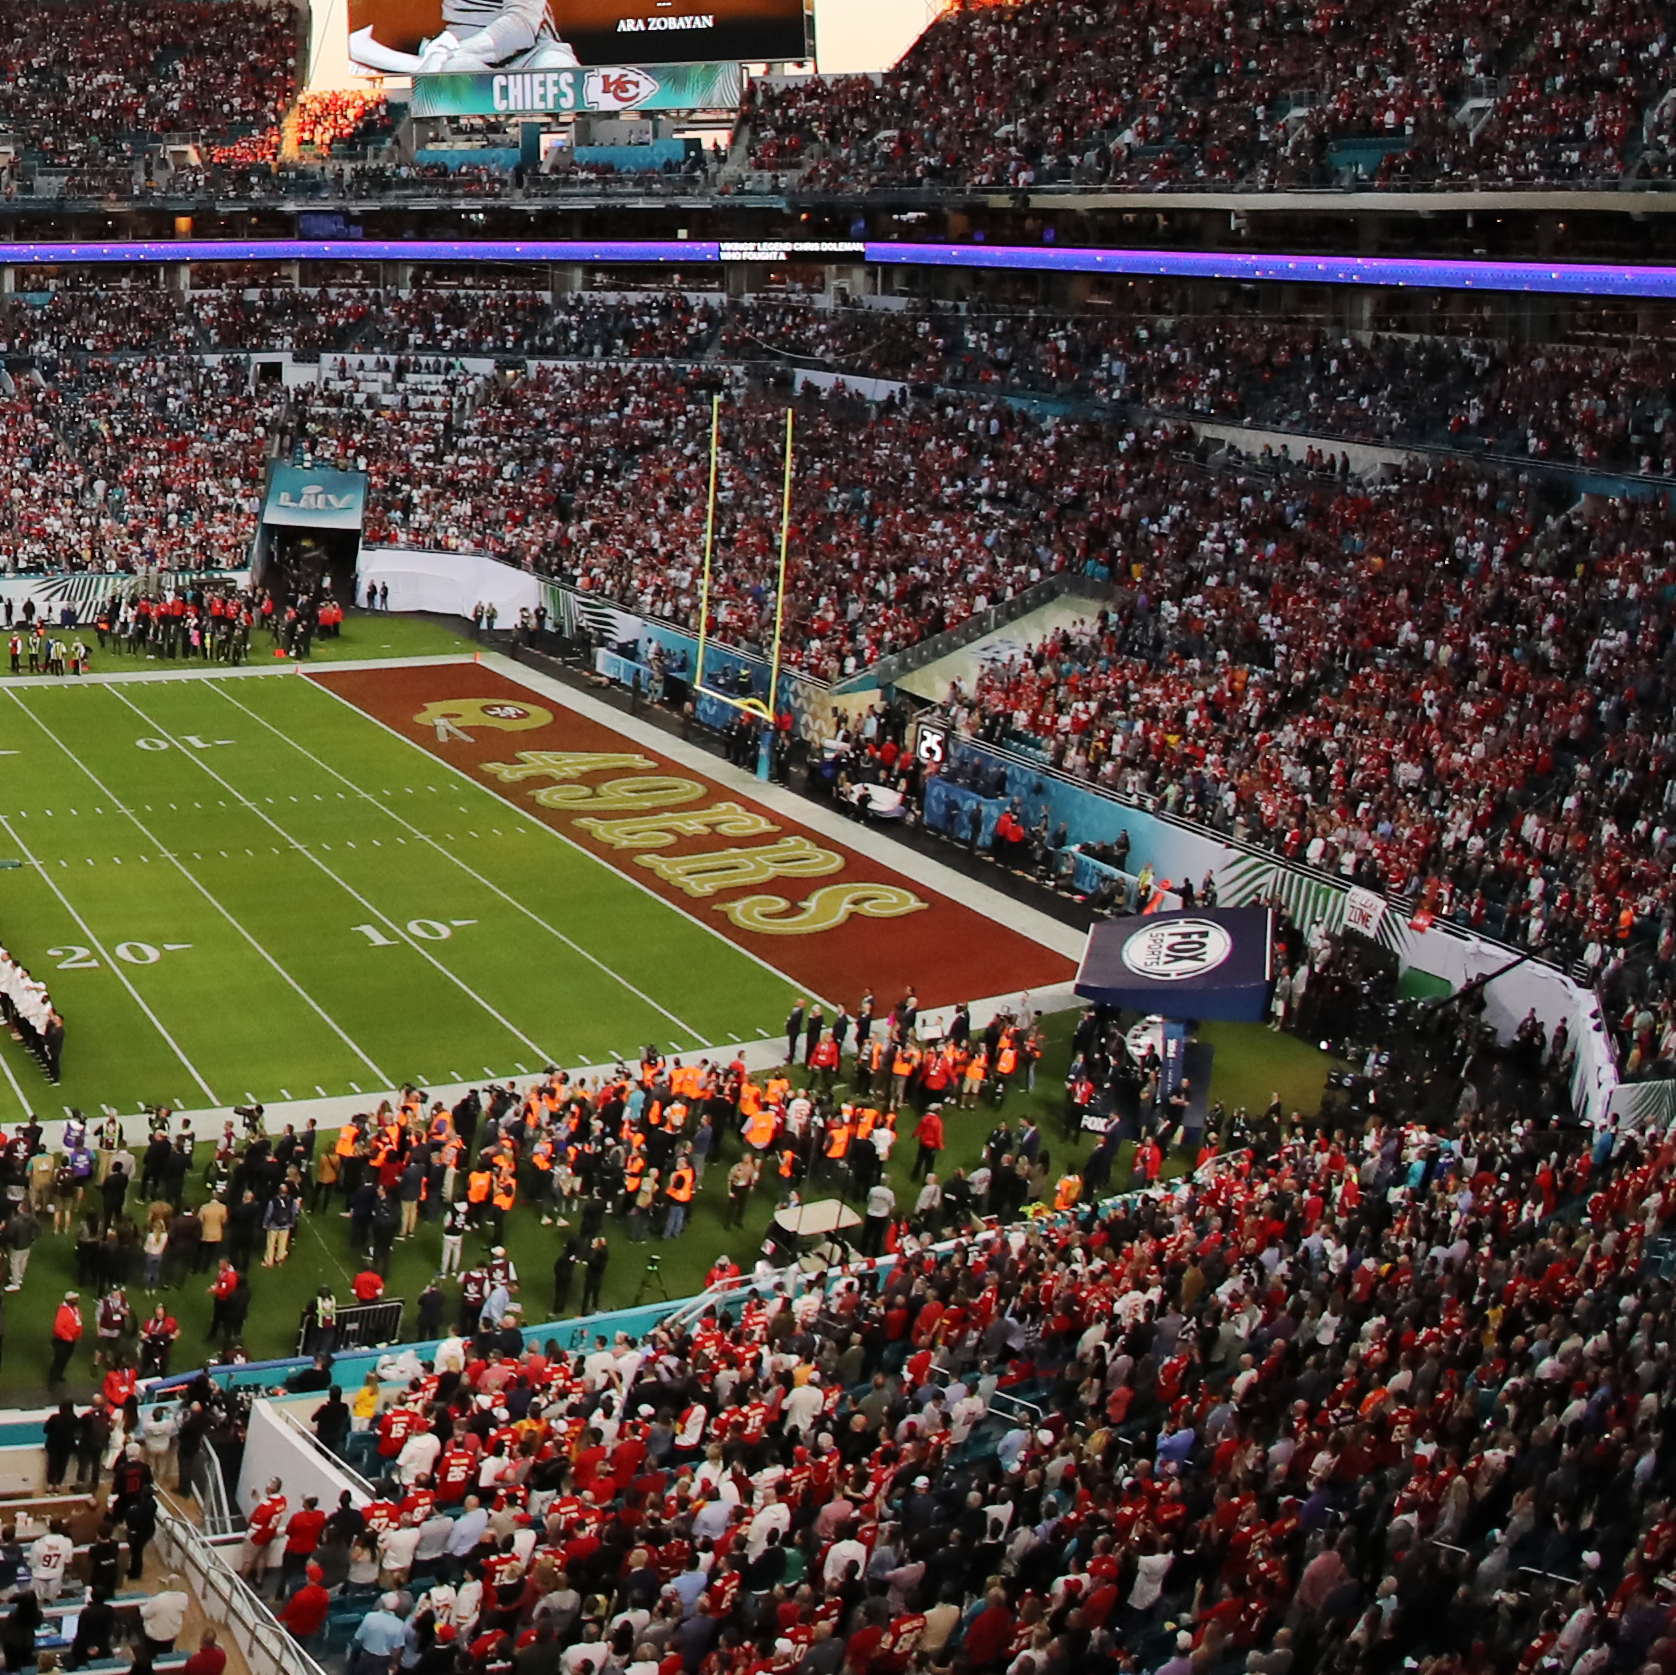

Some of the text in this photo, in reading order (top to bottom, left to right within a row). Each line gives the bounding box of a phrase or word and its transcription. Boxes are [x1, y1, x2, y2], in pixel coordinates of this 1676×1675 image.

[617, 14, 714, 33] ARA ZOBAYAN
[492, 72, 575, 111] CHIEFS
[719, 251, 742, 260] WHO
[743, 251, 779, 260] FOUGHT
[757, 242, 793, 251] LEGEND
[793, 242, 820, 251] CHRIS
[136, 735, 213, 751] 10
[920, 730, 943, 762] 25
[479, 749, 929, 935] 49ERS
[352, 919, 451, 947] 10
[46, 941, 161, 971] 20
[1143, 932, 1165, 967] SPORTS
[1163, 929, 1209, 966] FOX
[1080, 1114, 1110, 1133] FOX
[390, 1422, 406, 1438] 15
[745, 1416, 762, 1436] 15
[41, 1553, 60, 1568] 97
